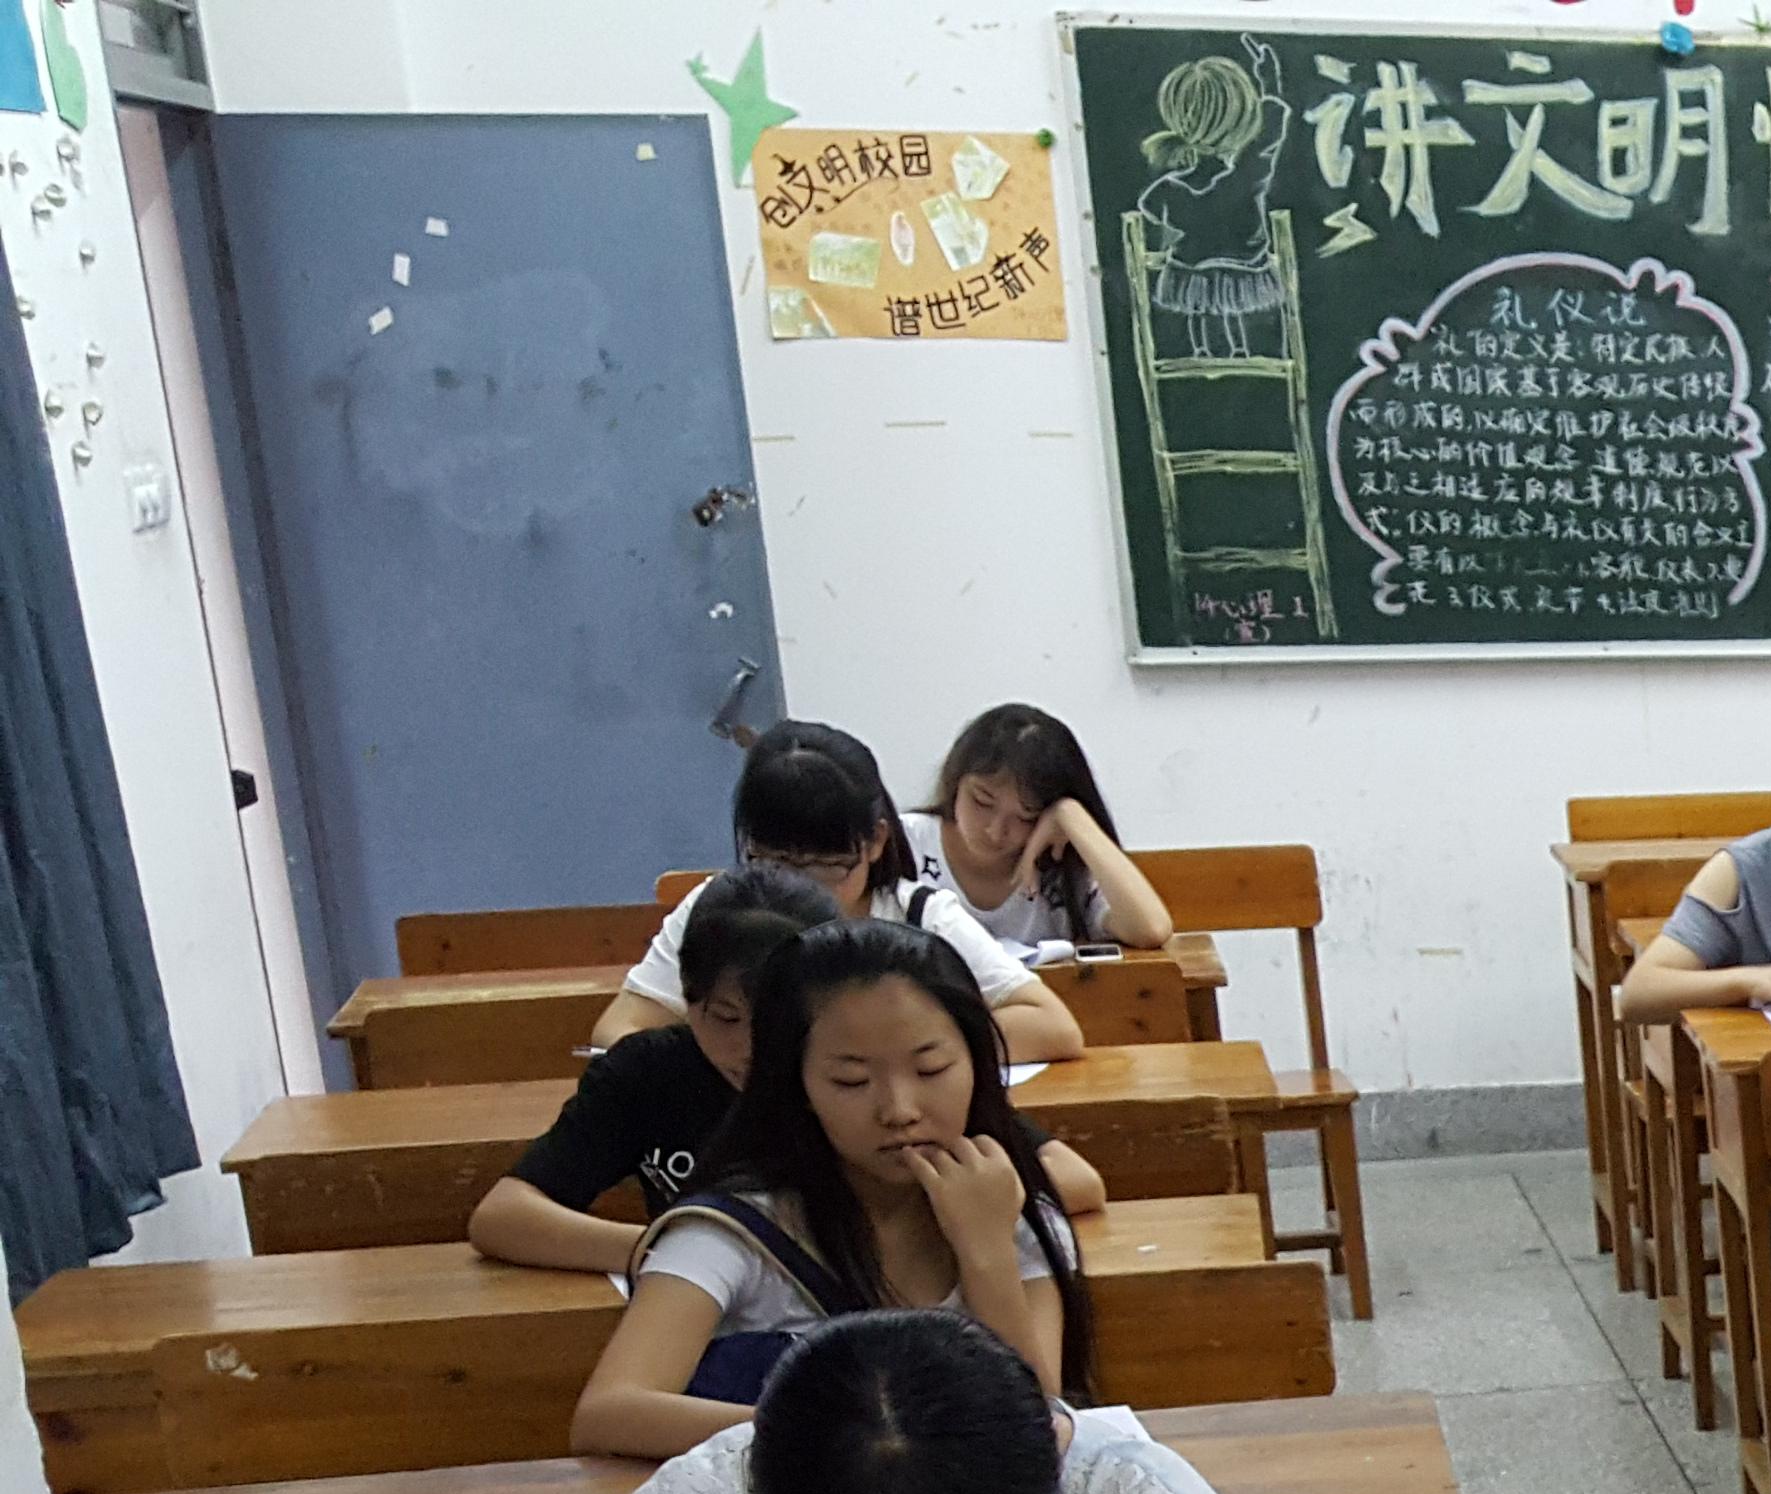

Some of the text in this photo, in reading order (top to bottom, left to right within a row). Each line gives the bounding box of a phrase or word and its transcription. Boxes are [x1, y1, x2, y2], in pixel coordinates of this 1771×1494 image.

[760, 134, 932, 228] 创文明校园
[880, 227, 1051, 337] 谱世纪新声
[1490, 286, 1648, 330] 礼仪说
